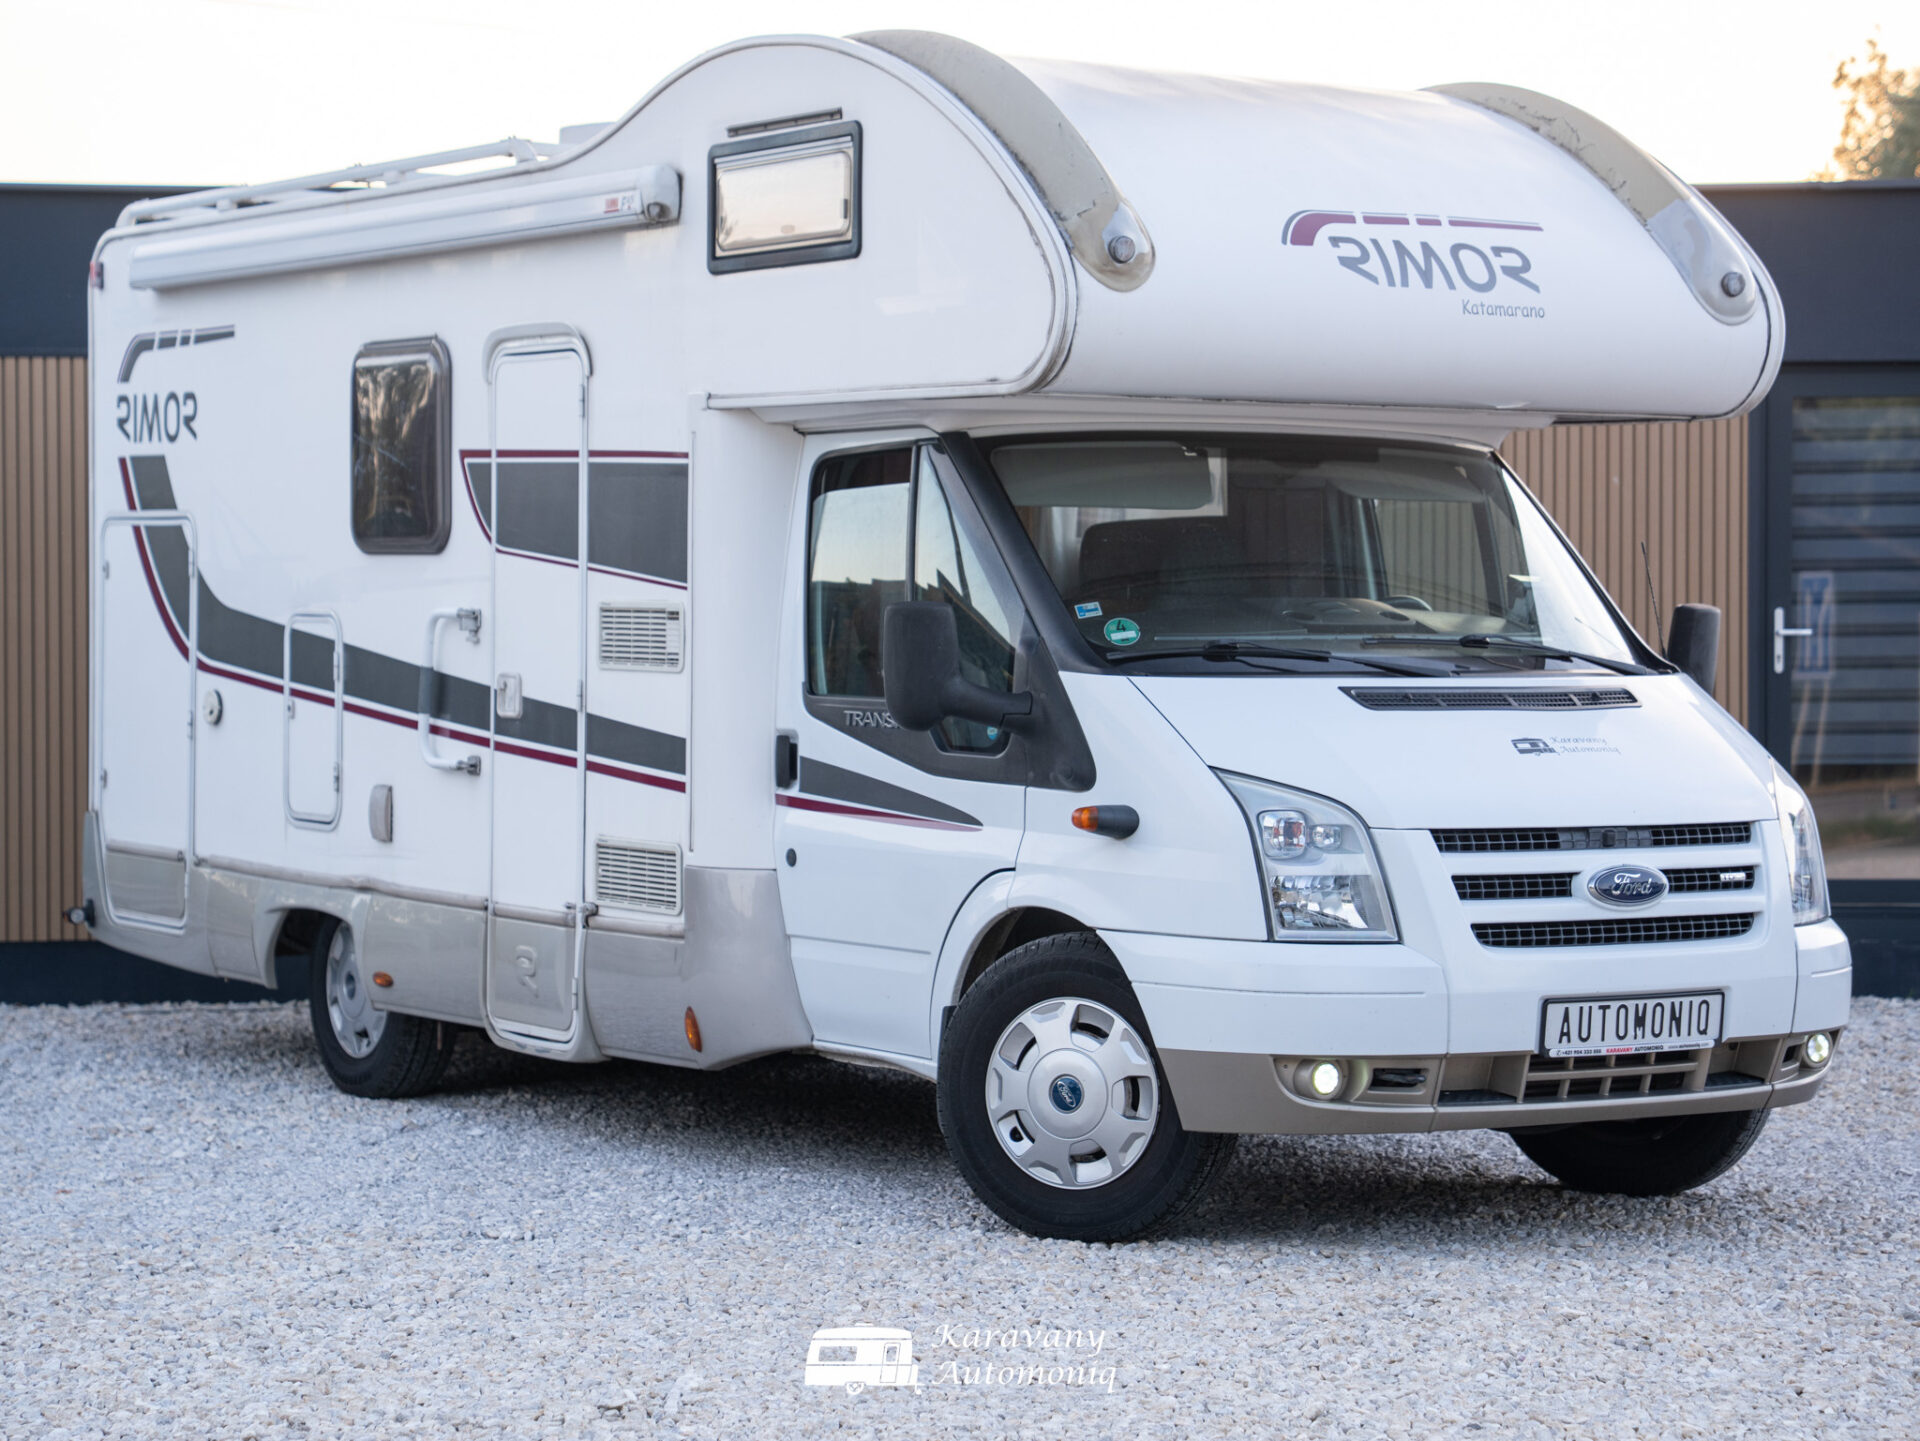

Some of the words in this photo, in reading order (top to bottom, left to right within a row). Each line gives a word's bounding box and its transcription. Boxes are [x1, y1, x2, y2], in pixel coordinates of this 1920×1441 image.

[1328, 235, 1541, 294] RIMOR
[1461, 299, 1546, 319] Katamarano
[116, 391, 198, 443] RIMOR
[1116, 619, 1127, 631] 4
[843, 710, 900, 729] TRANS
[1611, 872, 1653, 896] Ford
[1558, 999, 1711, 1044] AUTOMONIQ
